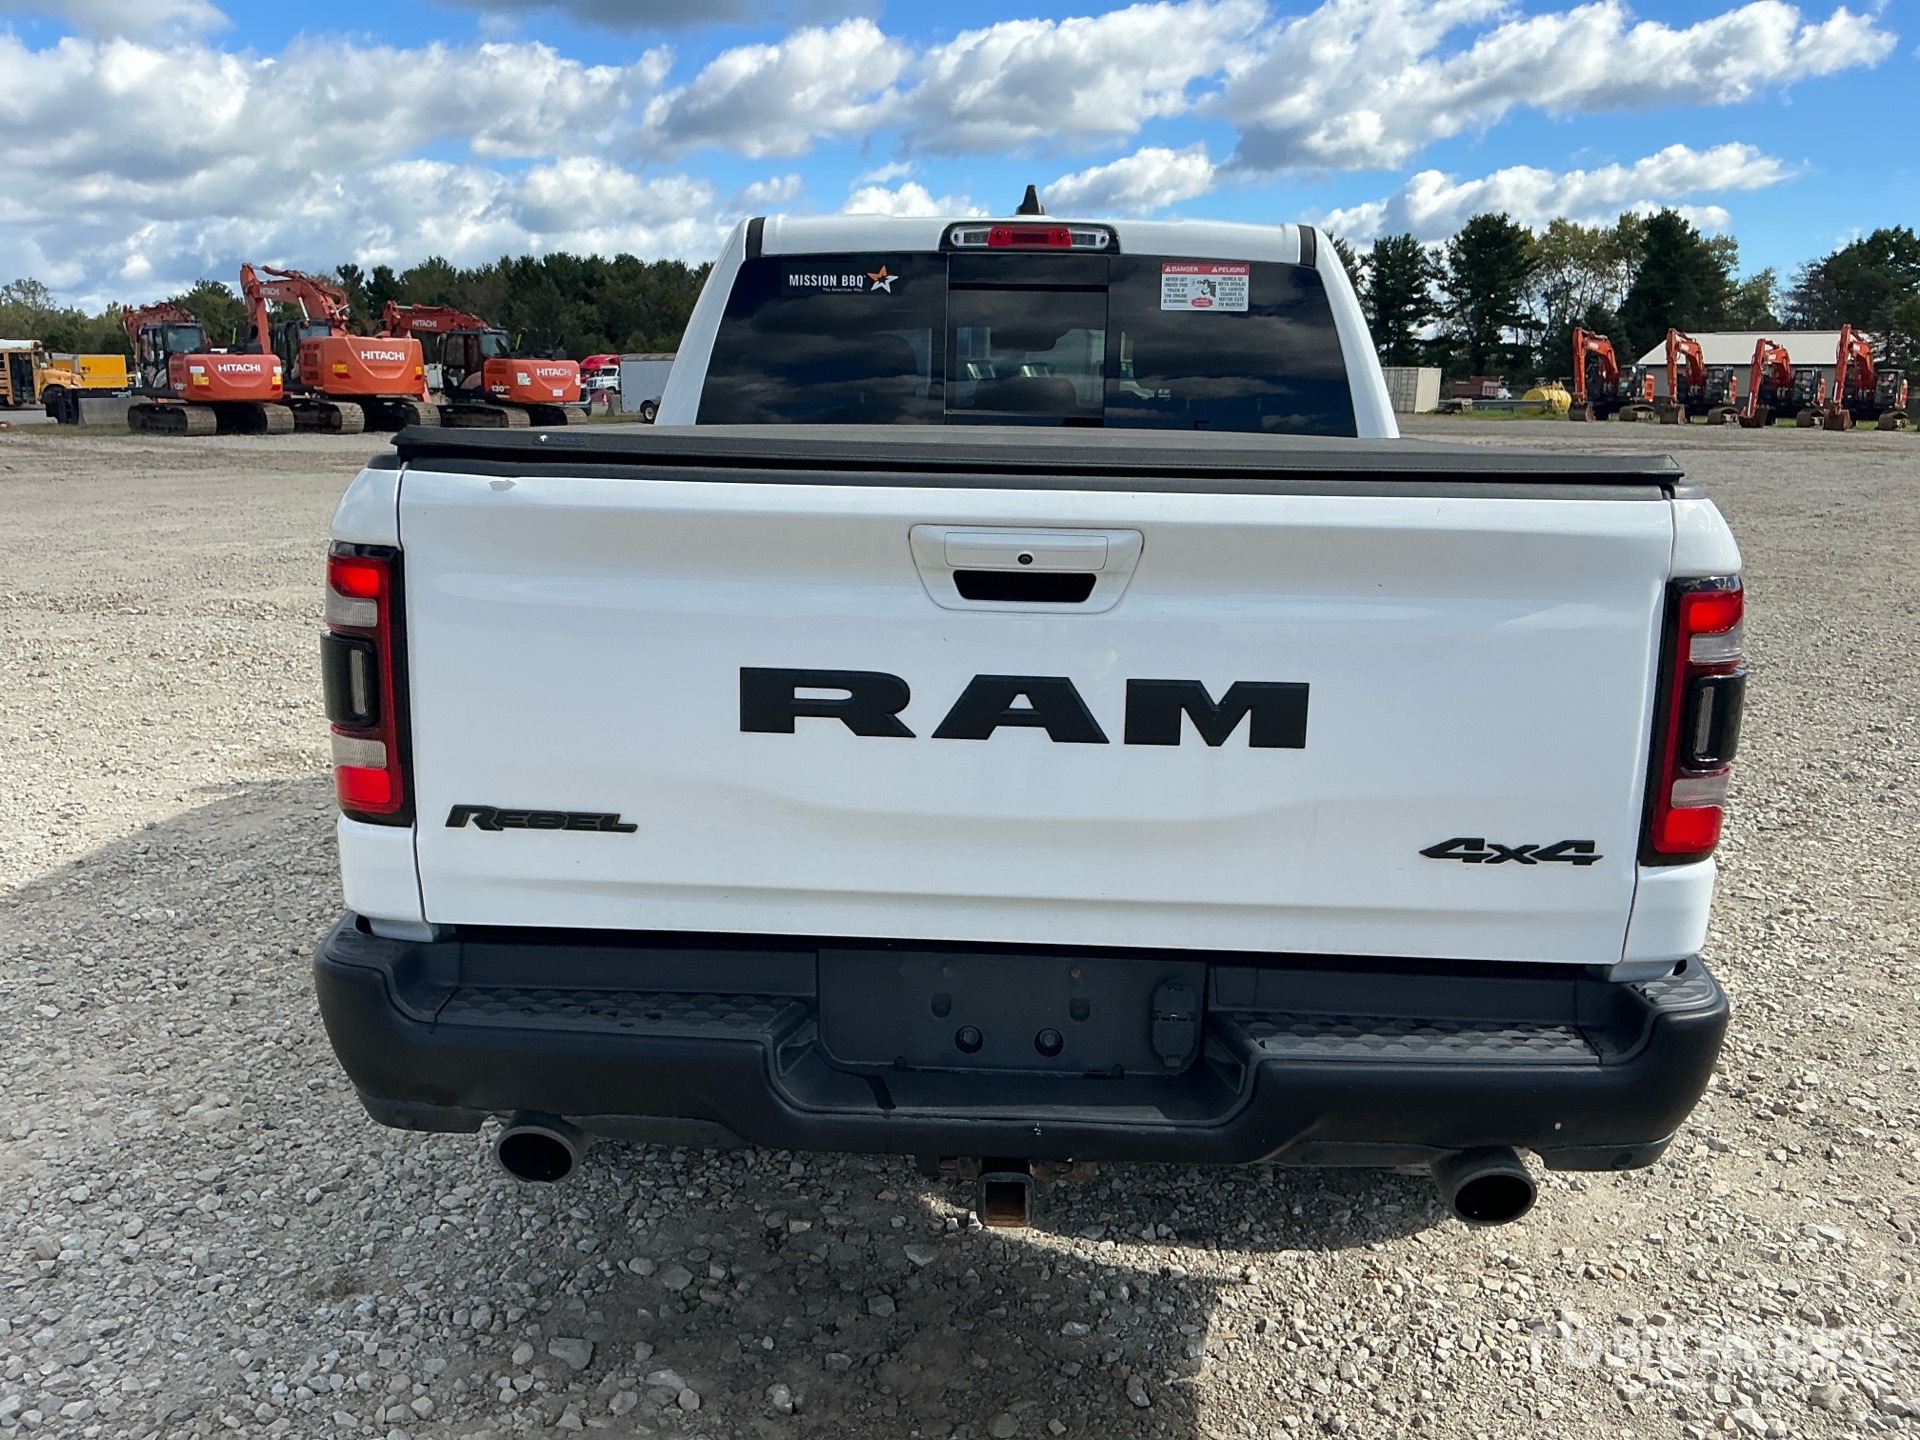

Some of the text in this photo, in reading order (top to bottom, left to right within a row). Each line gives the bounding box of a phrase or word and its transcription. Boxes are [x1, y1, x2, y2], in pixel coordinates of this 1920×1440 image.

[789, 274, 864, 288] MISSION BBQ
[260, 287, 279, 296] HITACHI
[412, 319, 437, 328] HITACHI
[361, 350, 405, 361] HITACHI
[218, 363, 261, 372] HITACHI
[536, 368, 571, 376] HITACHI
[740, 667, 1309, 748] RAM
[445, 804, 638, 833] REBEL
